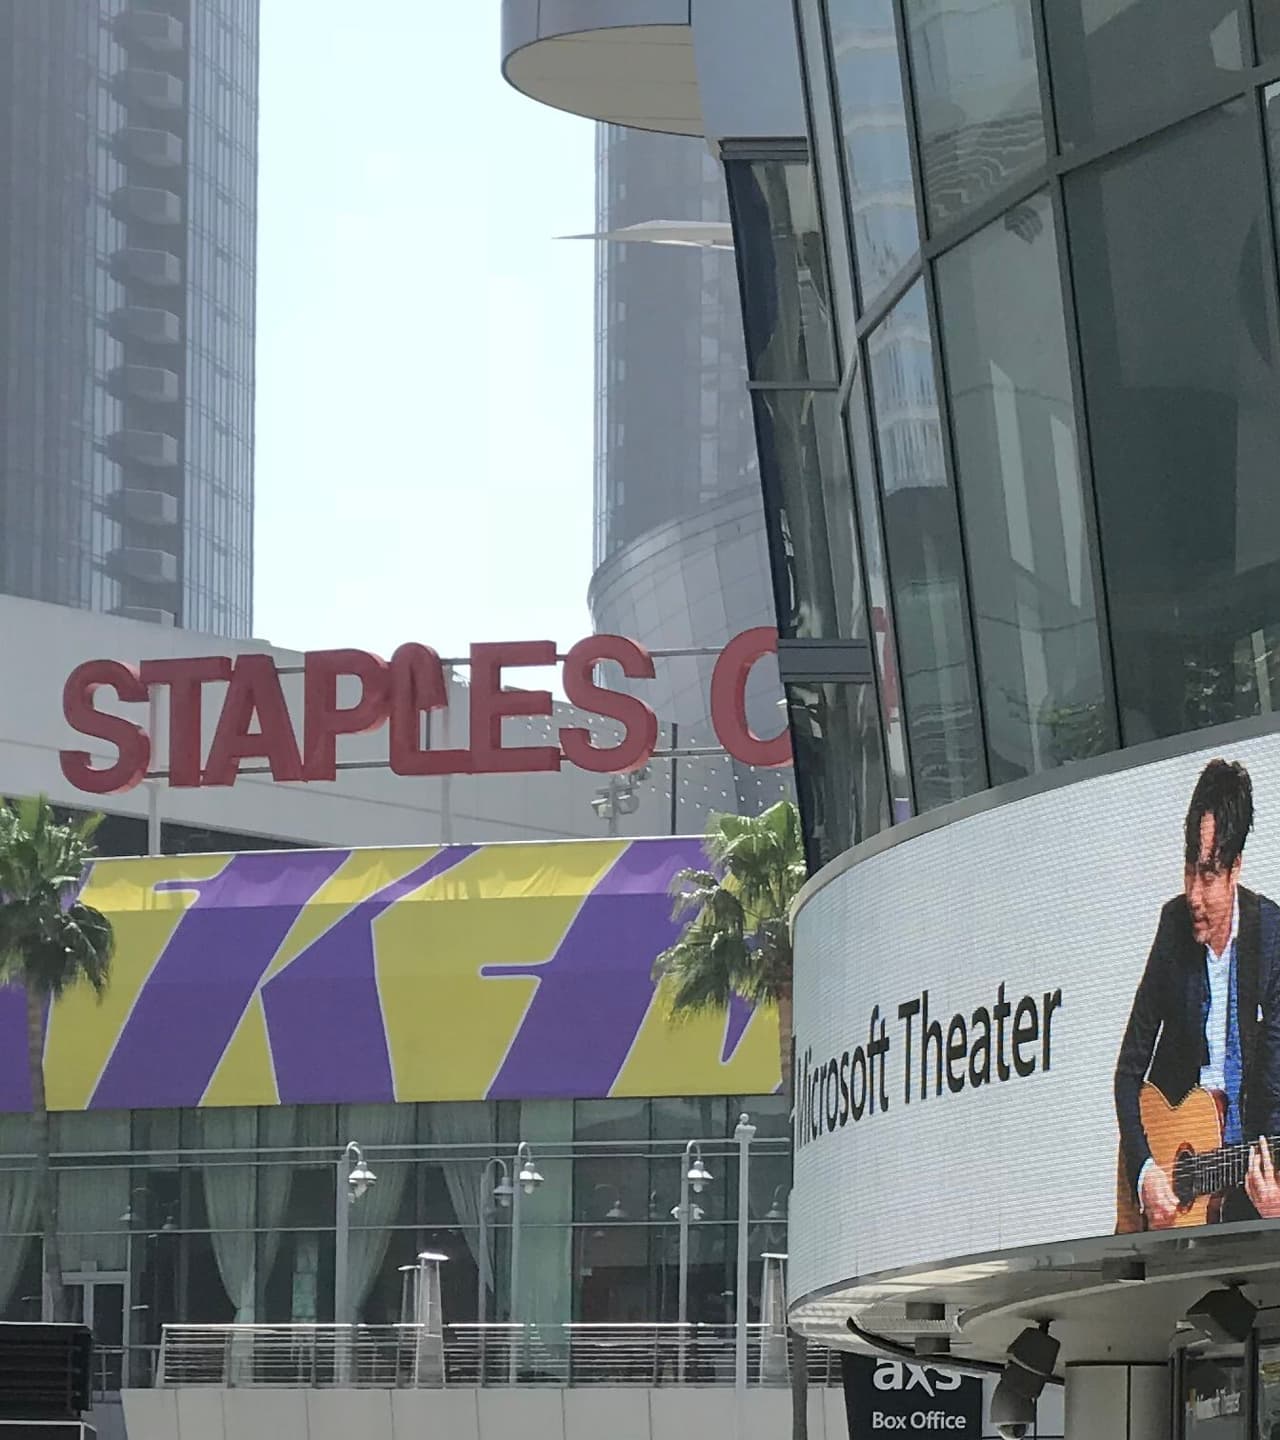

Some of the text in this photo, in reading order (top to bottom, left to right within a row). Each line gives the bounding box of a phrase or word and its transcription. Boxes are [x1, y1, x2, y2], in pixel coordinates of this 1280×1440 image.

[60, 632, 660, 794] STAPLES
[898, 981, 1062, 1104] Theater
[872, 1410, 967, 1430] Box Office
